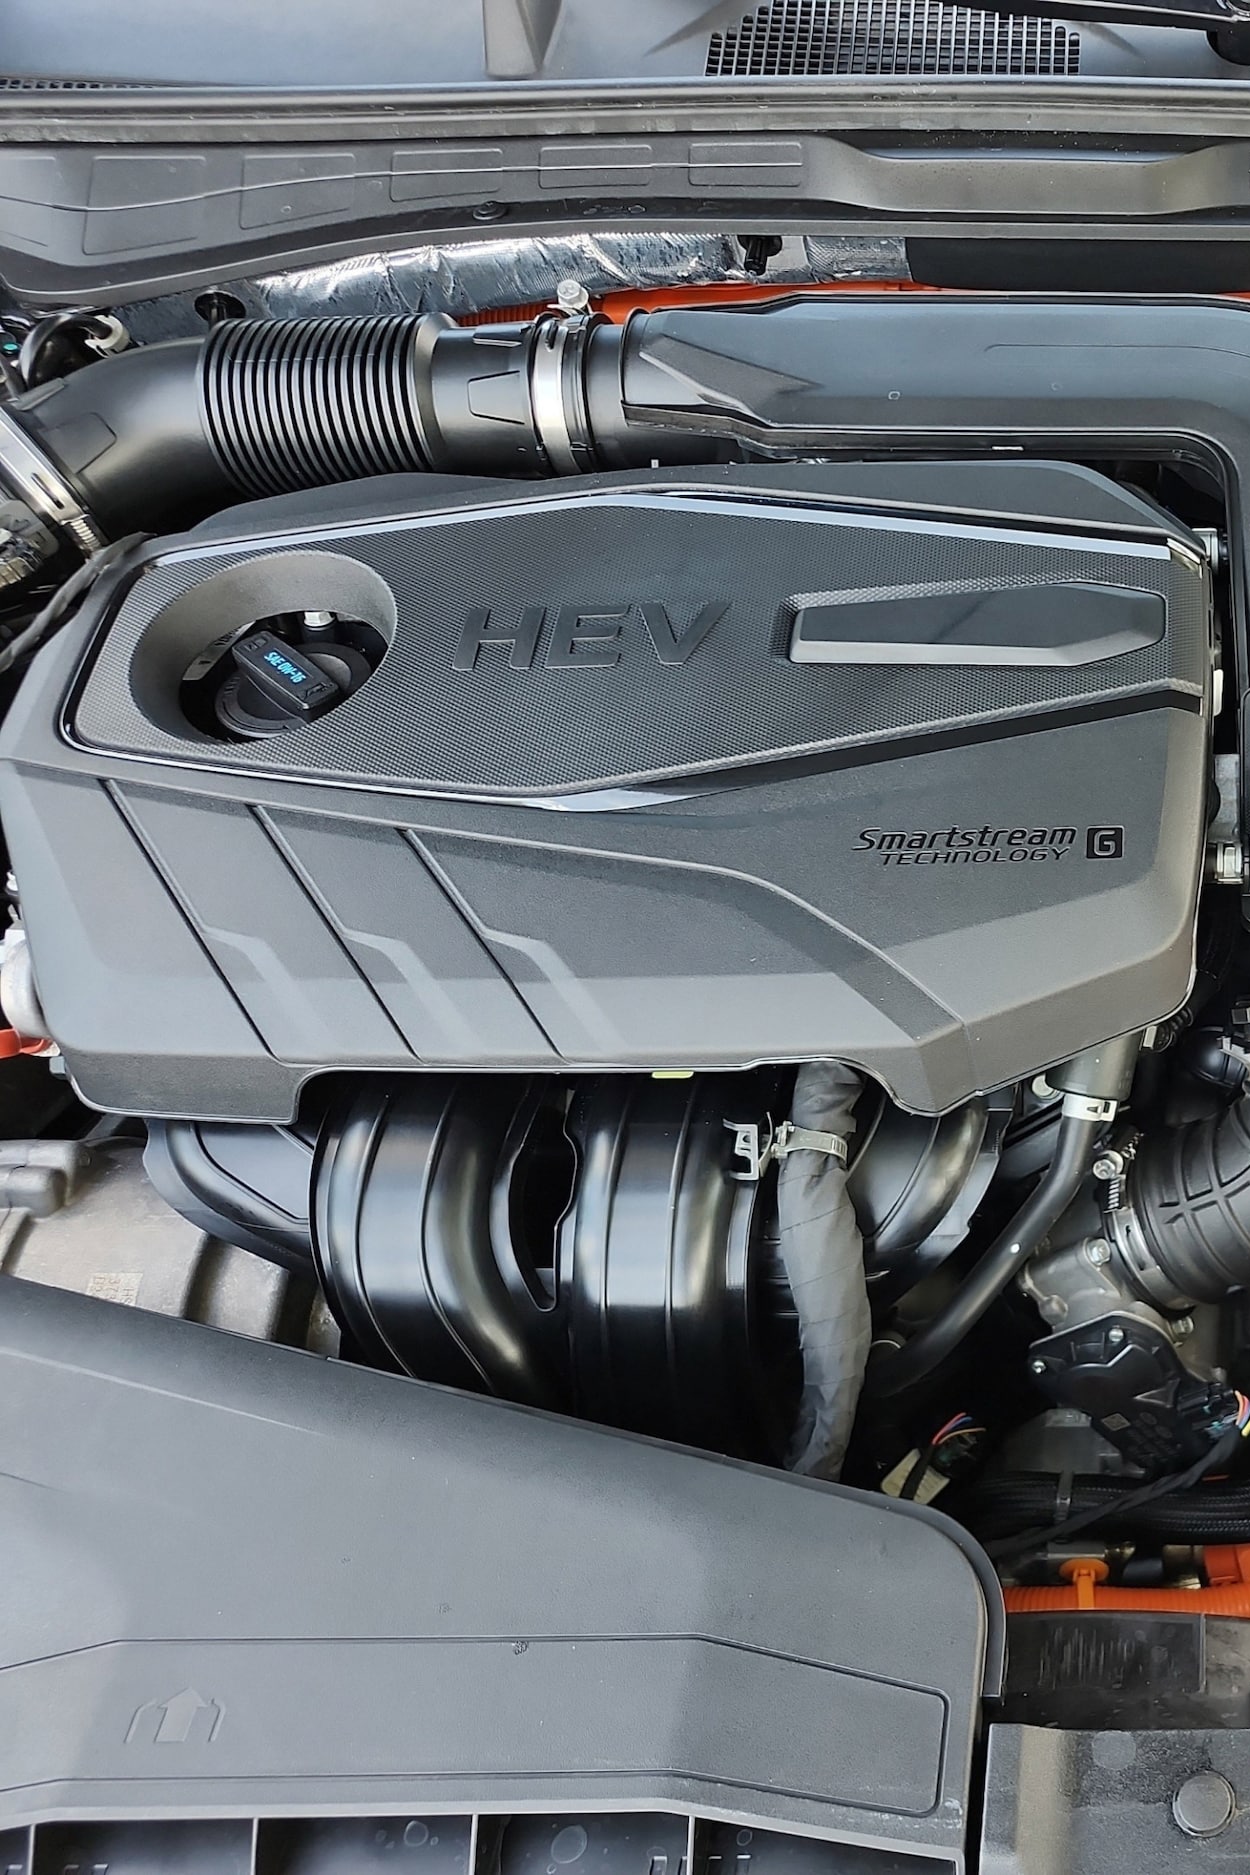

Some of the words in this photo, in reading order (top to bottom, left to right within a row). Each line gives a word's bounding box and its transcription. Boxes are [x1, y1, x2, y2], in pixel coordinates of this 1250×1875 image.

[453, 602, 728, 670] HEV
[263, 651, 285, 667] SAE
[853, 824, 1076, 851] Smartstream
[1088, 827, 1120, 858] G
[880, 847, 1070, 865] TECHNOLOGY
